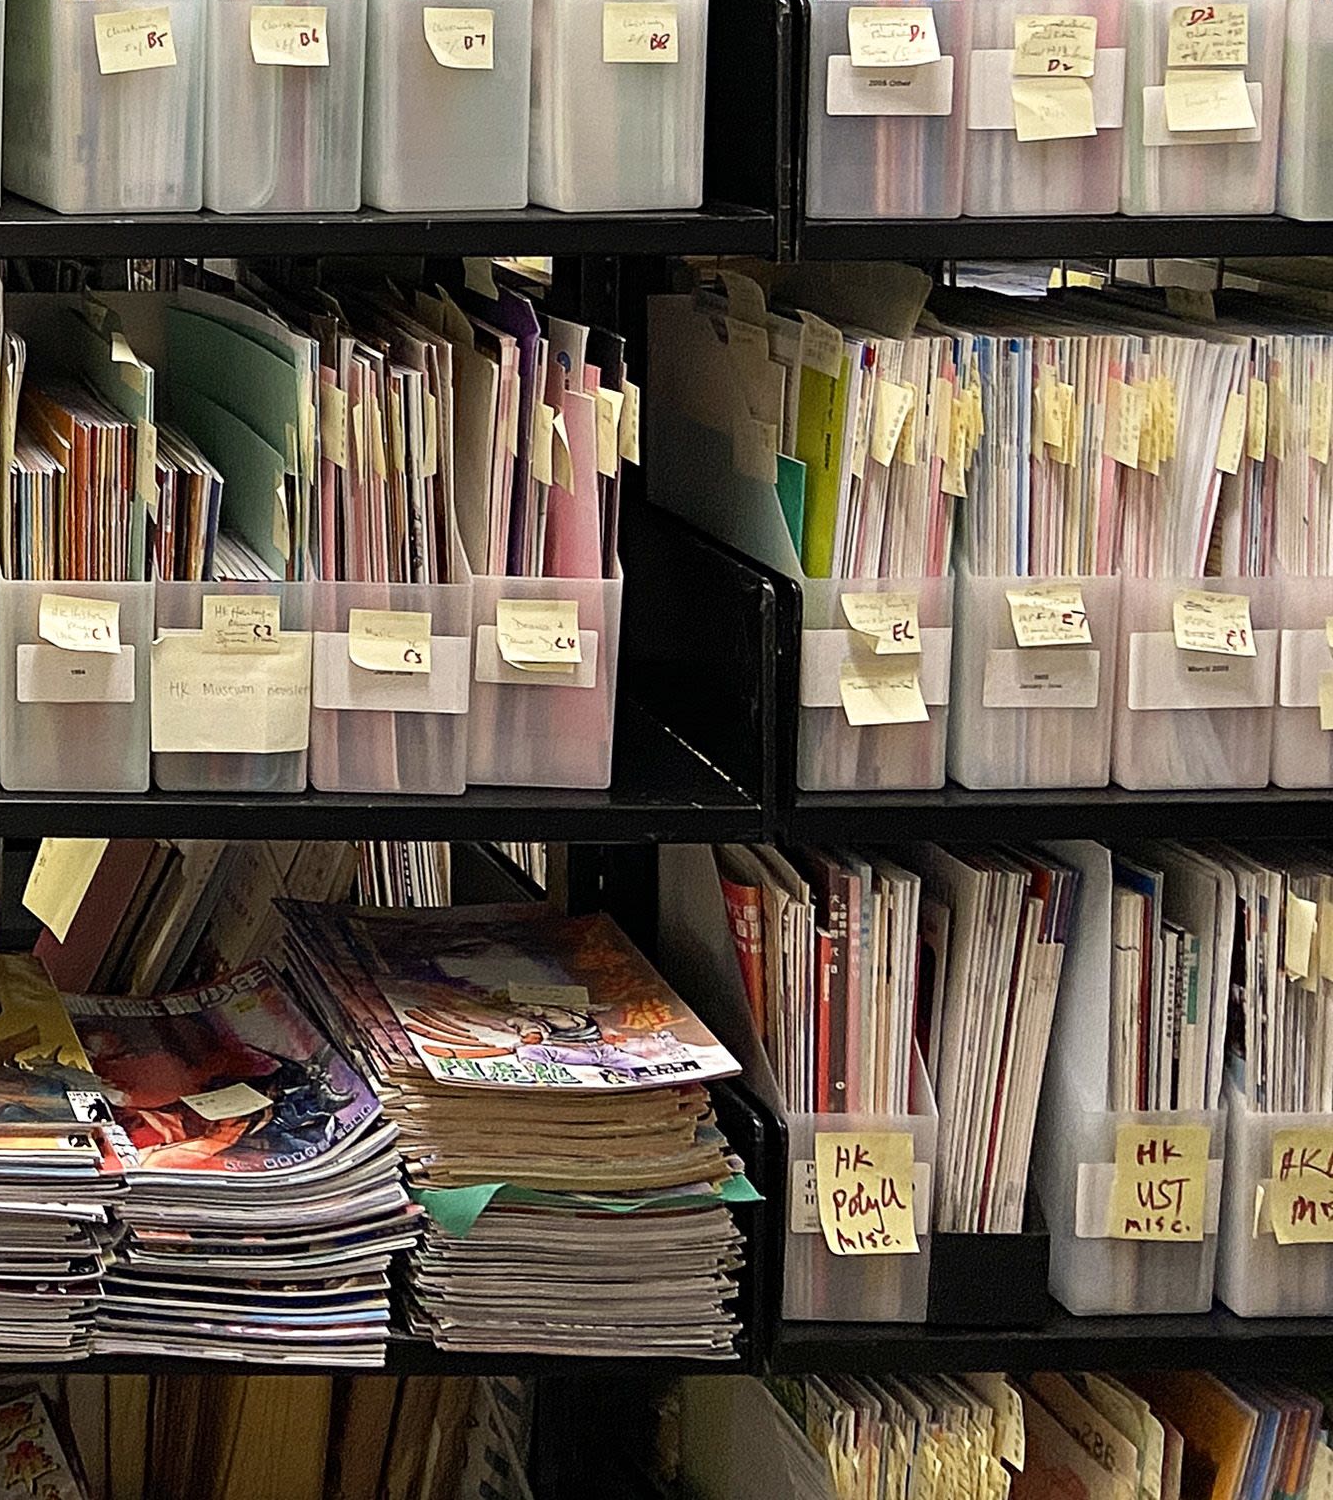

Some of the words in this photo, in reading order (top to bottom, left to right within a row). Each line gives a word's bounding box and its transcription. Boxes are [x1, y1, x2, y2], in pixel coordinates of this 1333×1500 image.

[147, 31, 168, 49] B5
[300, 28, 319, 46] B6
[909, 24, 926, 42] D1
[1048, 59, 1074, 72] D2
[92, 625, 111, 640] C1
[169, 681, 190, 696] HK
[202, 682, 255, 696] Museum
[835, 1144, 874, 1178] HK
[1136, 1139, 1183, 1165] HK
[832, 1177, 907, 1234] PolyU
[1136, 1178, 1191, 1218] UST
